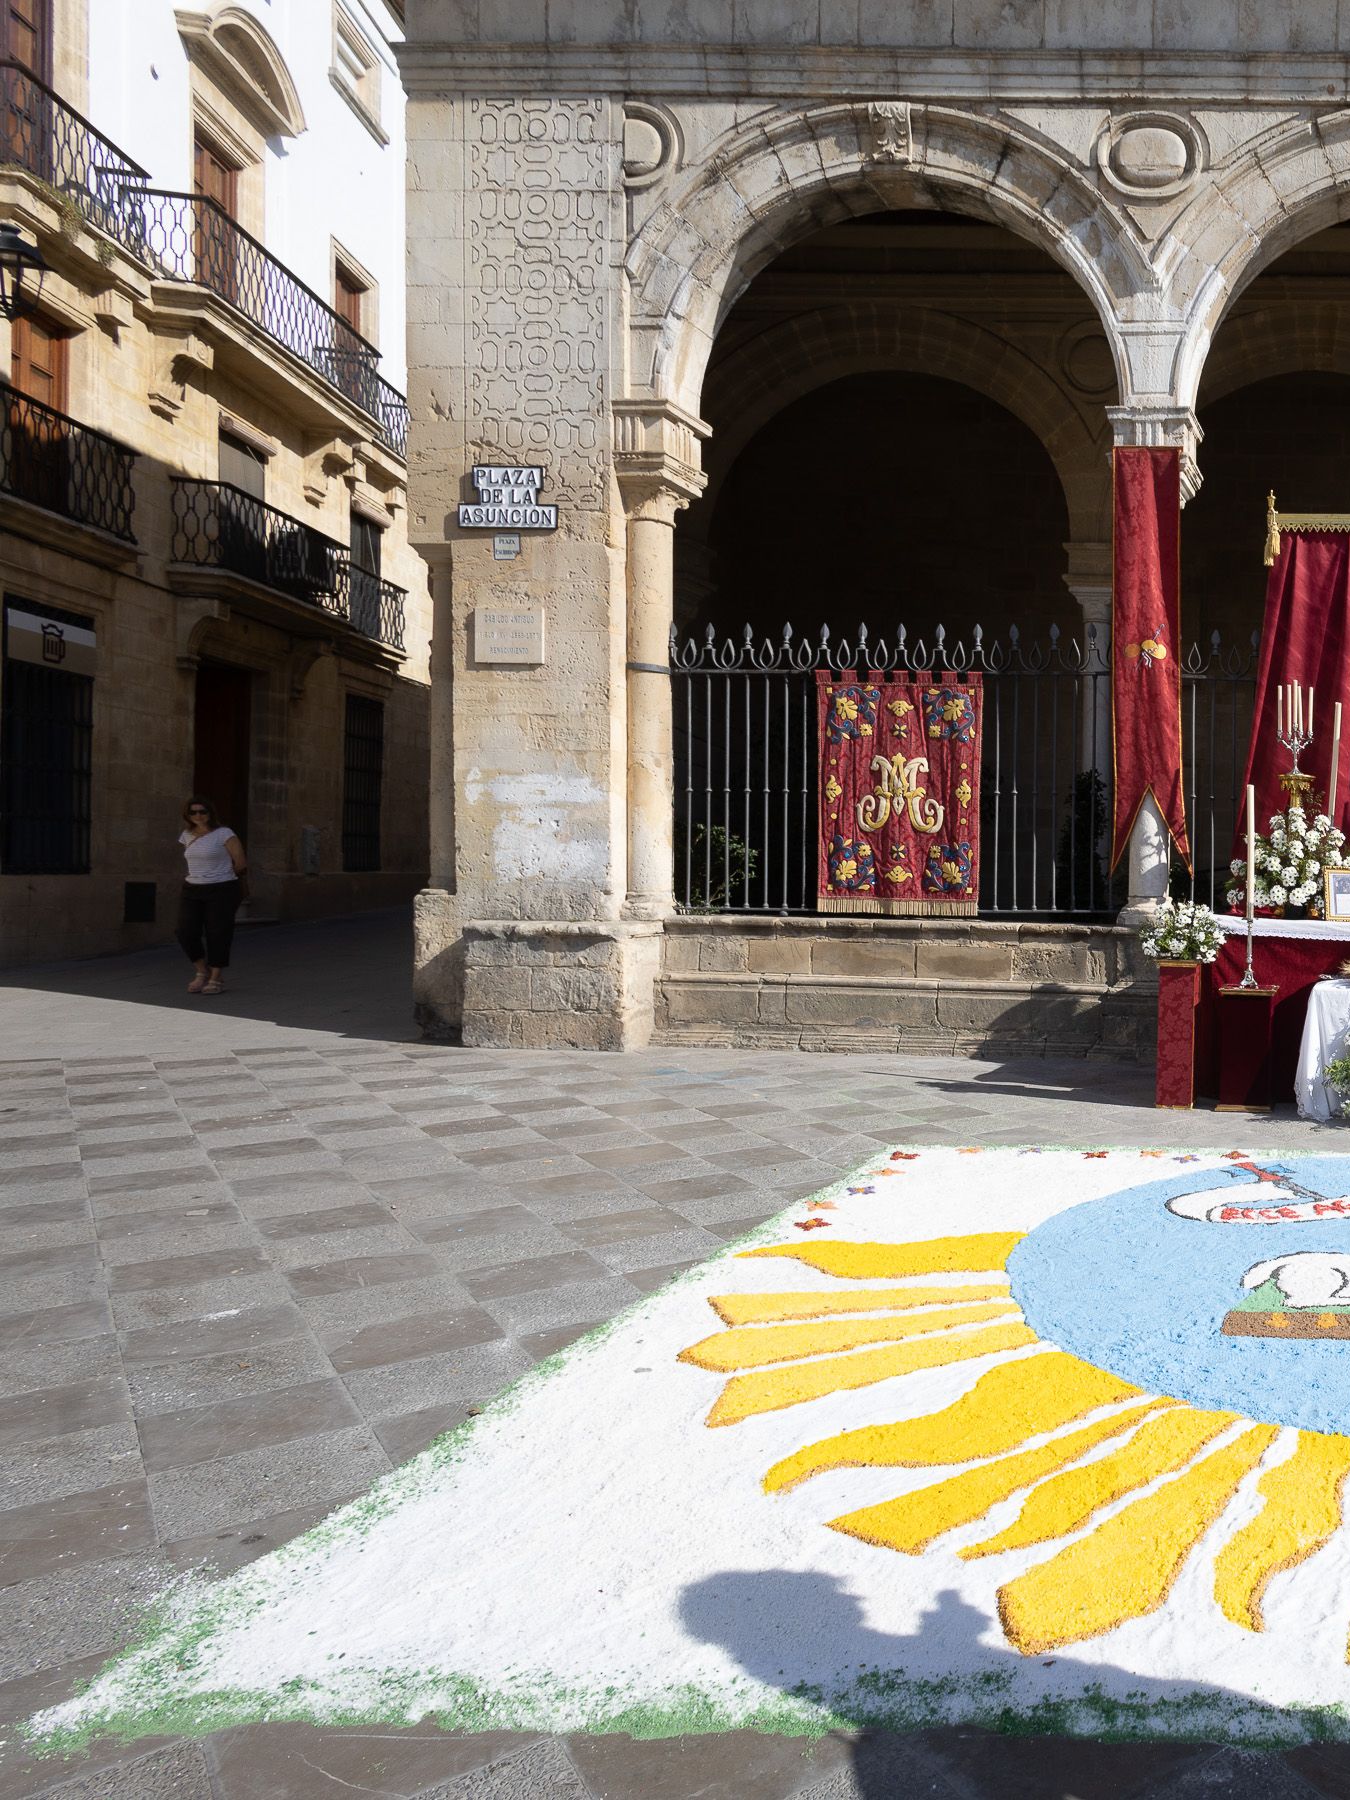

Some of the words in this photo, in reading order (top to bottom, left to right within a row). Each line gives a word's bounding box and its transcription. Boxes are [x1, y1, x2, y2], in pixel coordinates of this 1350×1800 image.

[476, 469, 537, 485] PLAZA
[481, 488, 503, 504] DE
[511, 488, 533, 504] LA
[1220, 1206, 1302, 1220] ECCE
